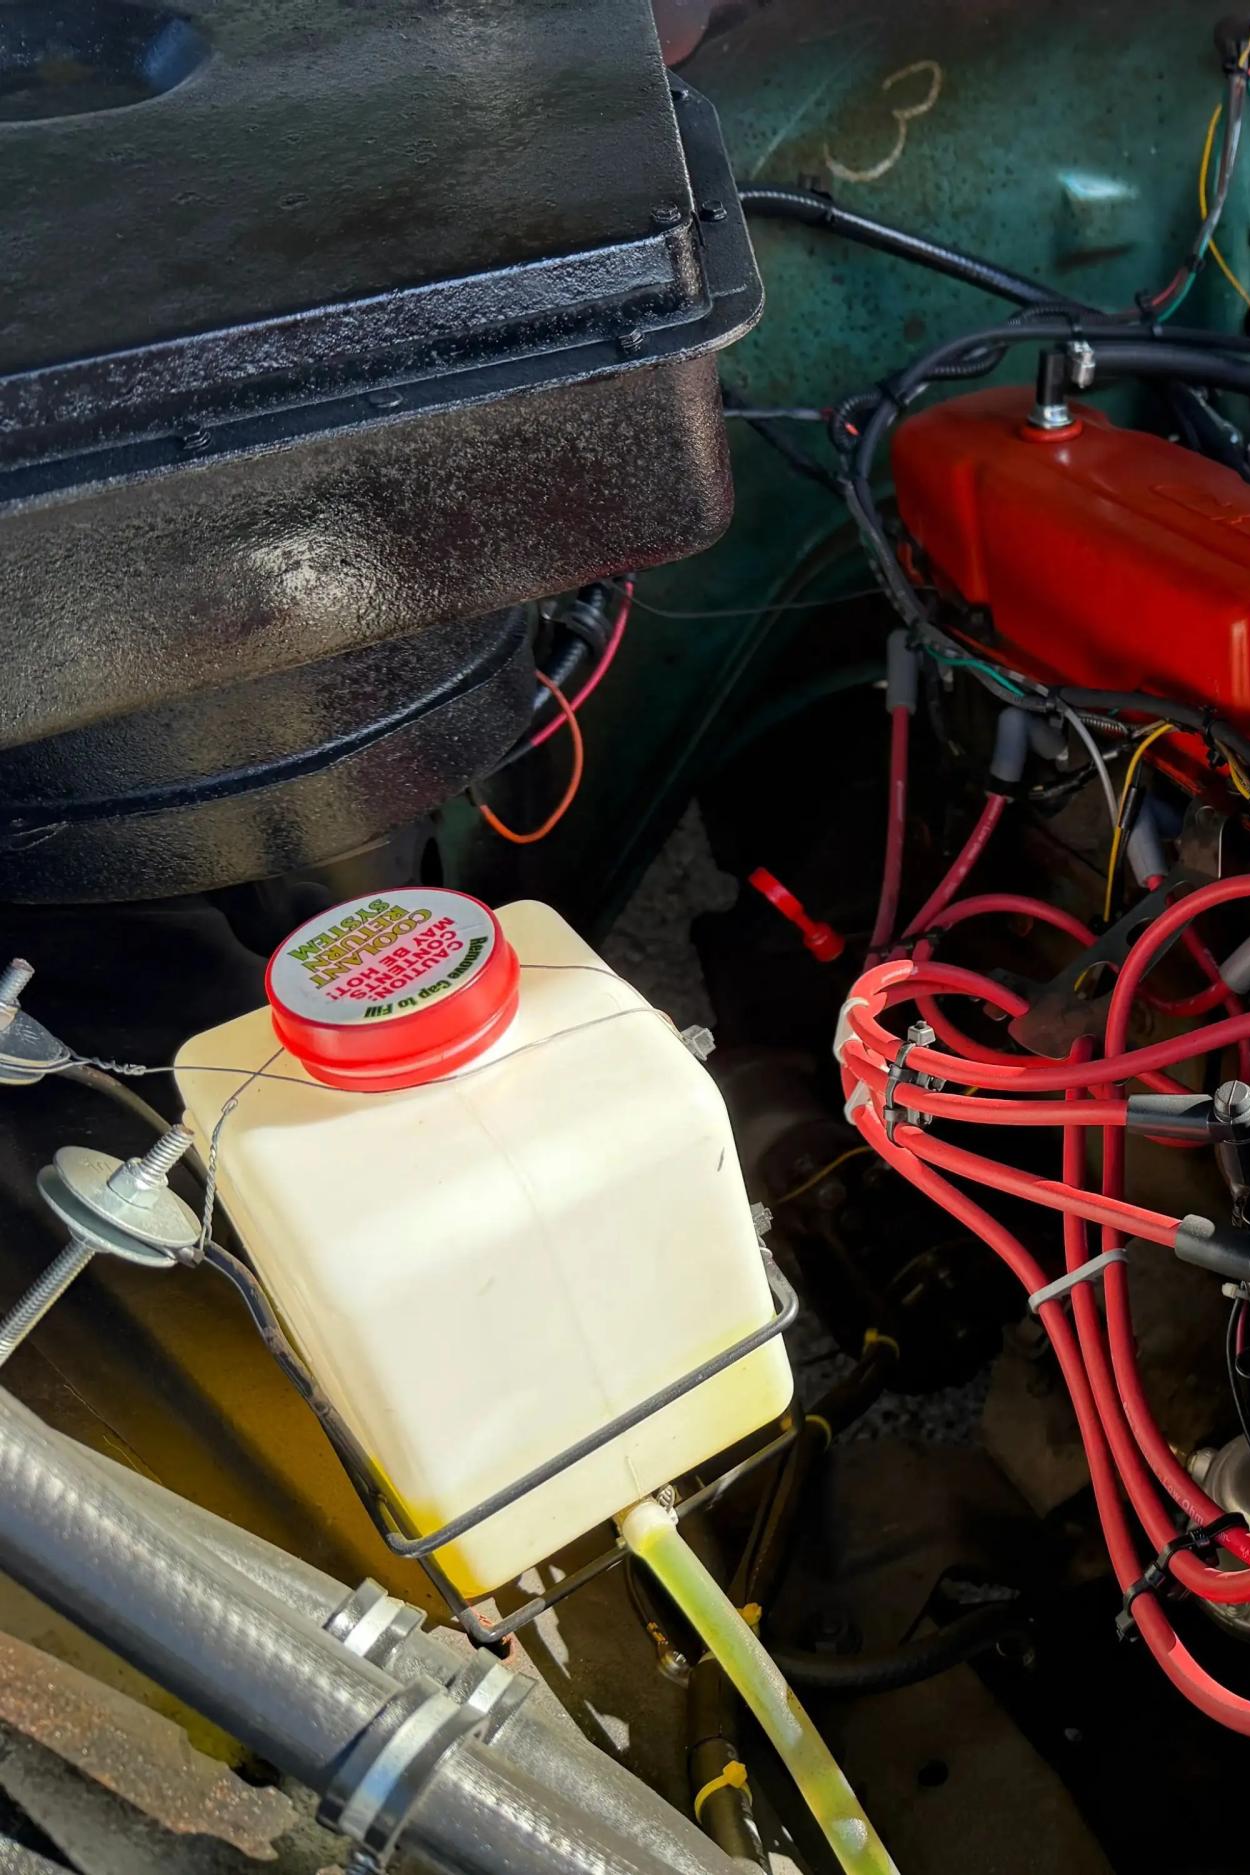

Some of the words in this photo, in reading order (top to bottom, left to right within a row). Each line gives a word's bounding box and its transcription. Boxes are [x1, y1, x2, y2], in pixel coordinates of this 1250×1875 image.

[287, 898, 390, 961] SYSTEM
[302, 905, 411, 973] RETURN
[413, 917, 455, 947] MAY
[308, 908, 432, 989] COOLANT
[379, 947, 411, 967] BE
[447, 936, 488, 980] Remove
[350, 930, 457, 1000] CONTENTS
[327, 967, 379, 1001] HOT!
[418, 979, 452, 999] Cap
[364, 1004, 393, 1019] Fill
[398, 999, 418, 1010] to
[1182, 1498, 1205, 1526] Ohm
